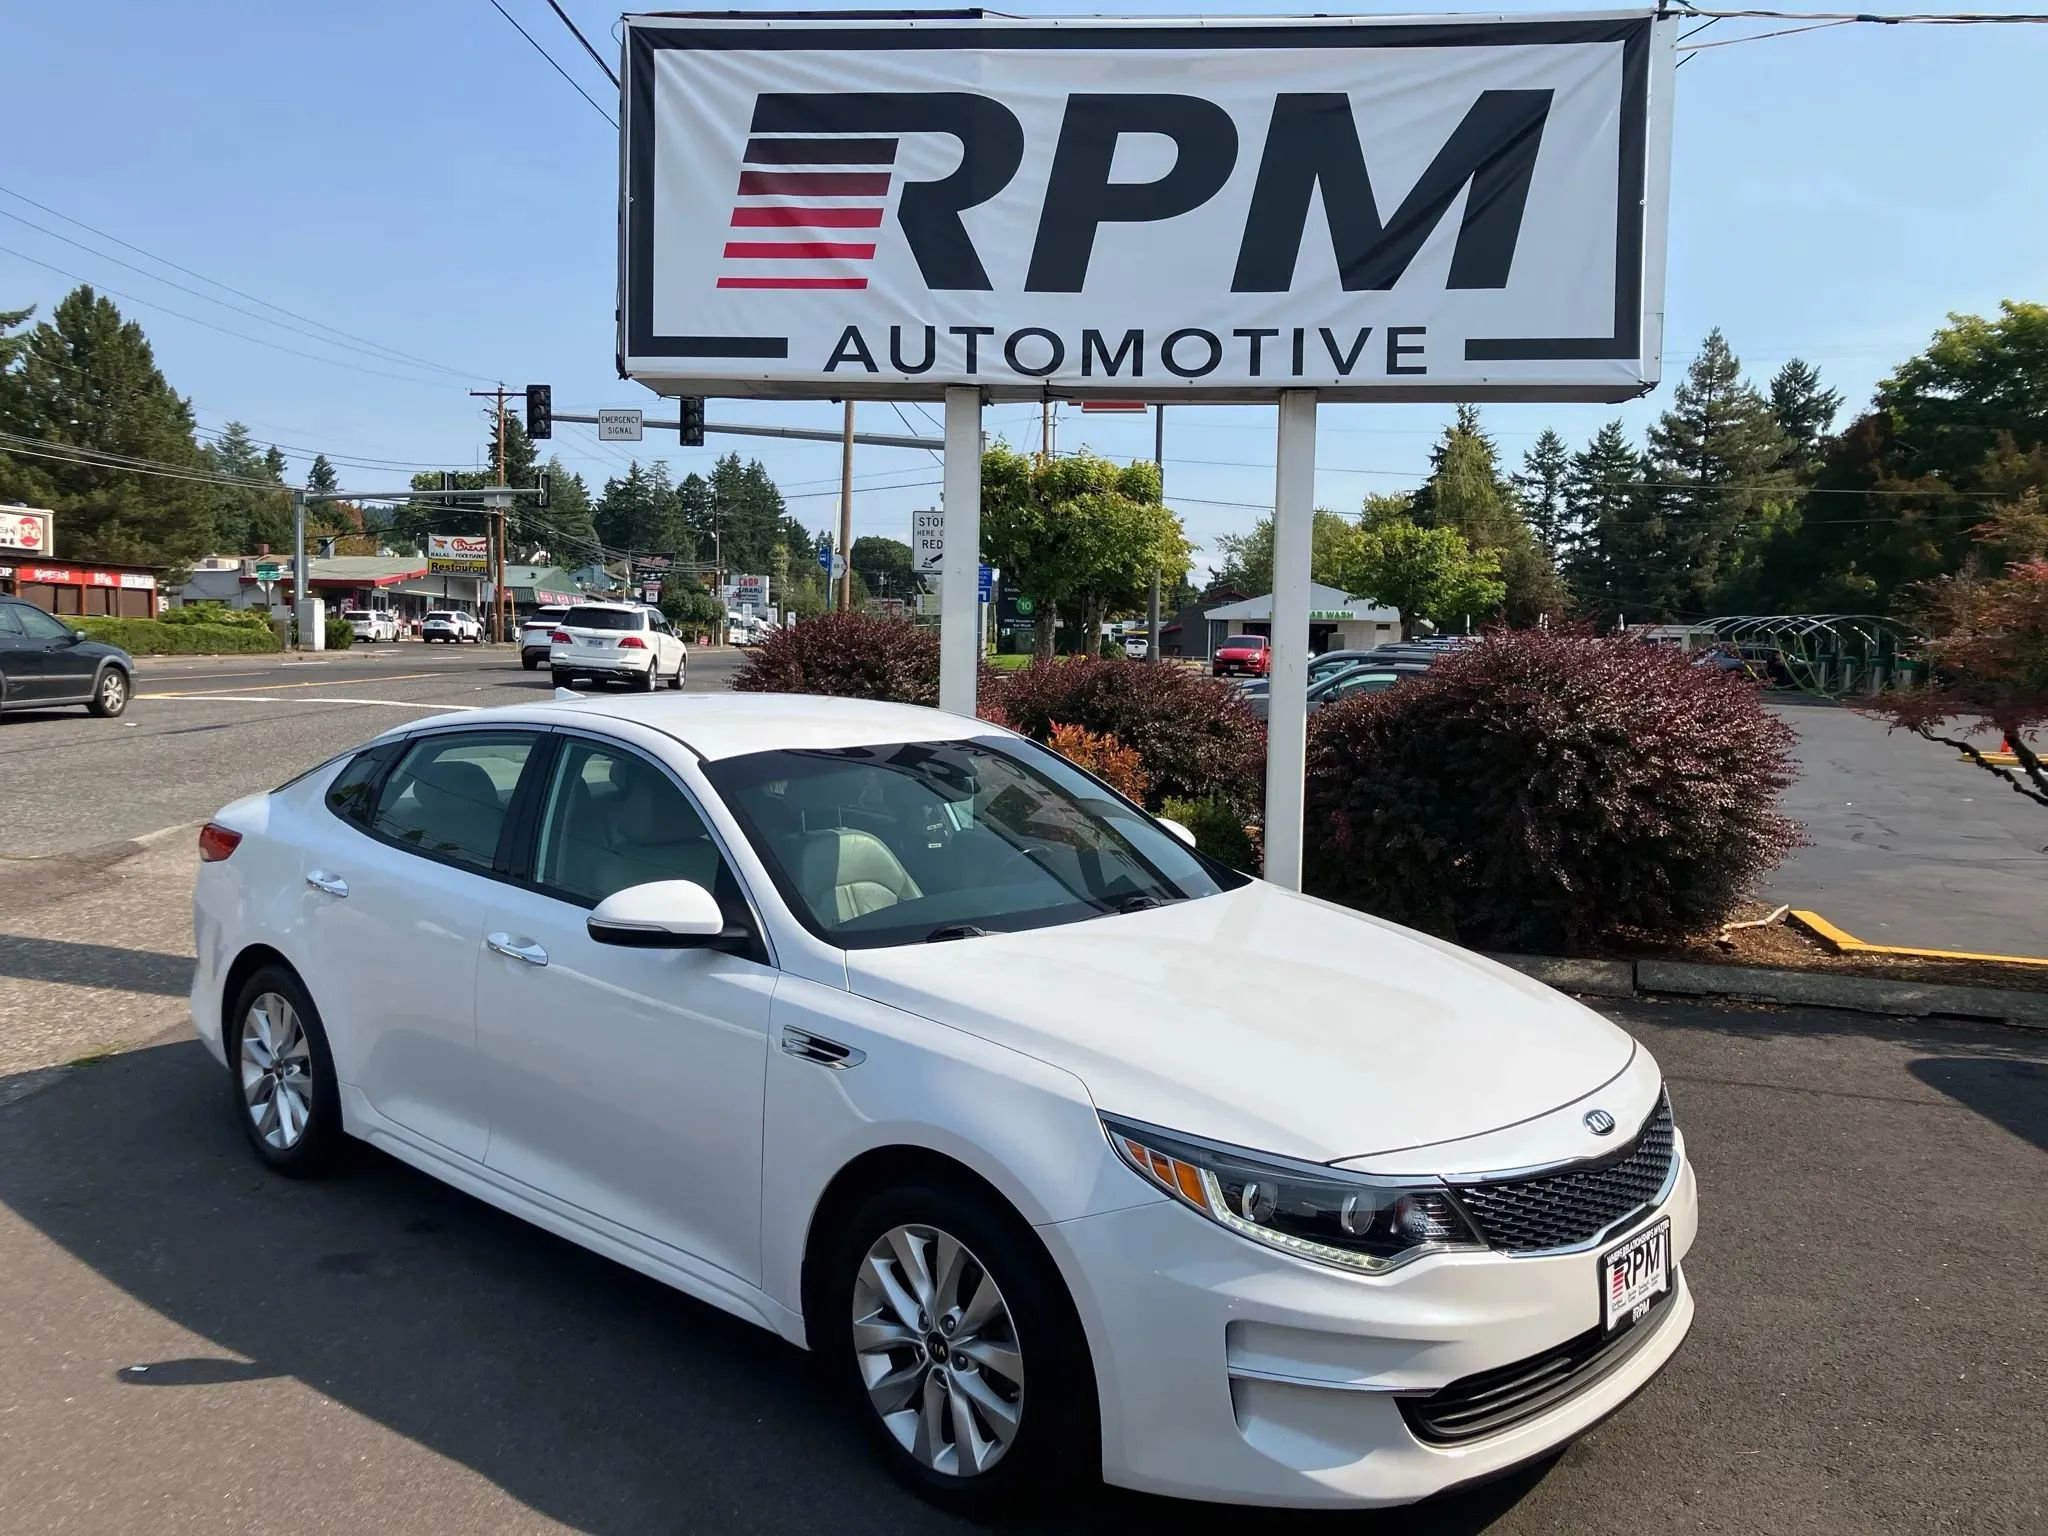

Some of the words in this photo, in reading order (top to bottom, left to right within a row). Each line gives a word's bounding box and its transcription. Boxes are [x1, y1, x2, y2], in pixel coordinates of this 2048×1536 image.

[716, 88, 1555, 292] RPM
[823, 325, 1427, 377] AUTOMOTIVE
[601, 415, 640, 424] EMERGENCY
[607, 426, 633, 435] SIGNAL
[917, 529, 935, 537] HERE
[922, 539, 944, 549] RED
[1326, 611, 1354, 619] WASH
[1587, 1111, 1615, 1132] KIA
[1612, 1234, 1660, 1300] RPM
[1632, 1298, 1650, 1322] RPM
[928, 1341, 946, 1357] KIA
